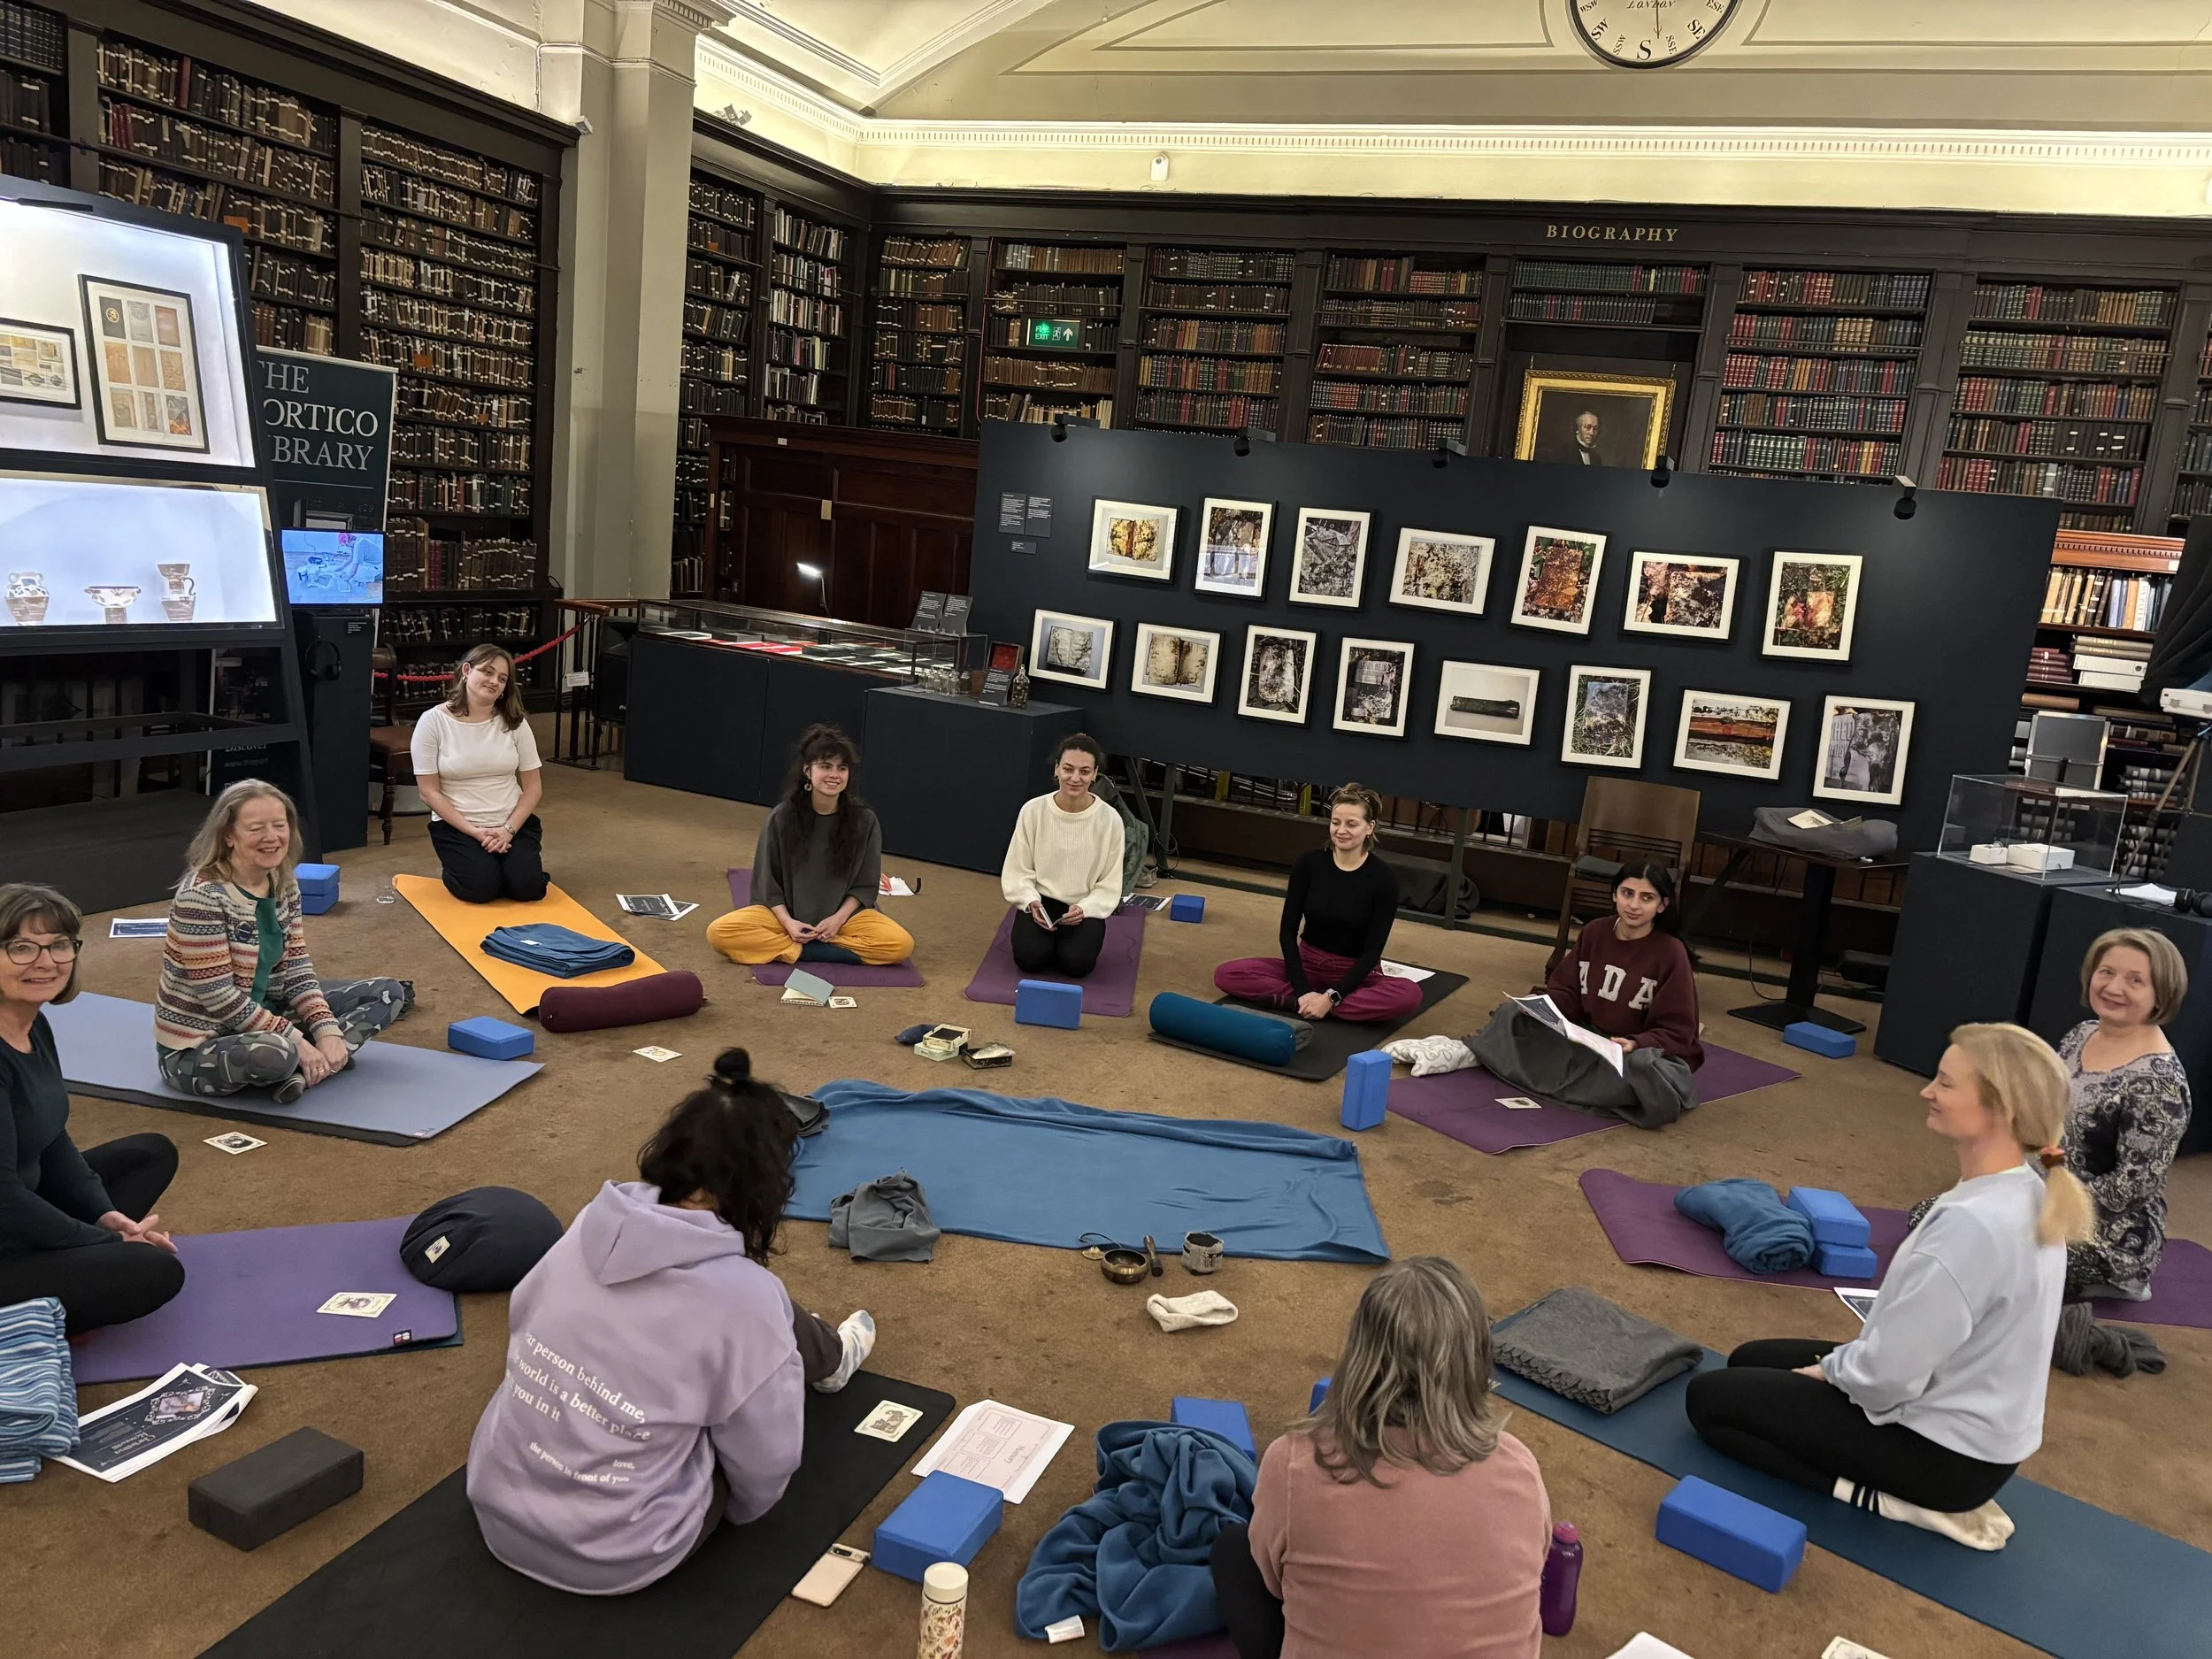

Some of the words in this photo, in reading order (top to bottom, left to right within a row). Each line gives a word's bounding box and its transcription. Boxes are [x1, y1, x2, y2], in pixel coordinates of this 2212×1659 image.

[1579, 0, 1598, 12] WSW
[1706, 0, 1724, 13] ESE
[1591, 18, 1609, 41] SW
[1687, 19, 1706, 40] SE
[1613, 35, 1626, 55] SSW
[1637, 39, 1652, 60] S
[1666, 35, 1677, 54] SSE
[1546, 225, 1678, 242] BIOGRAPHY
[258, 360, 309, 394] HE
[263, 398, 379, 437] ORTICO
[267, 434, 374, 471] BRARY
[518, 1359, 549, 1386] world
[549, 1379, 560, 1394] is
[559, 1390, 569, 1402] a
[570, 1393, 609, 1425] better
[533, 1342, 576, 1375] person
[577, 1366, 623, 1406] behind
[619, 1401, 646, 1424] me,
[513, 1384, 534, 1405] you
[535, 1396, 549, 1414] in
[551, 1407, 560, 1422] it
[529, 1442, 542, 1455] the
[540, 1450, 564, 1471] person
[573, 1471, 599, 1482] front
[600, 1472, 611, 1483] of
